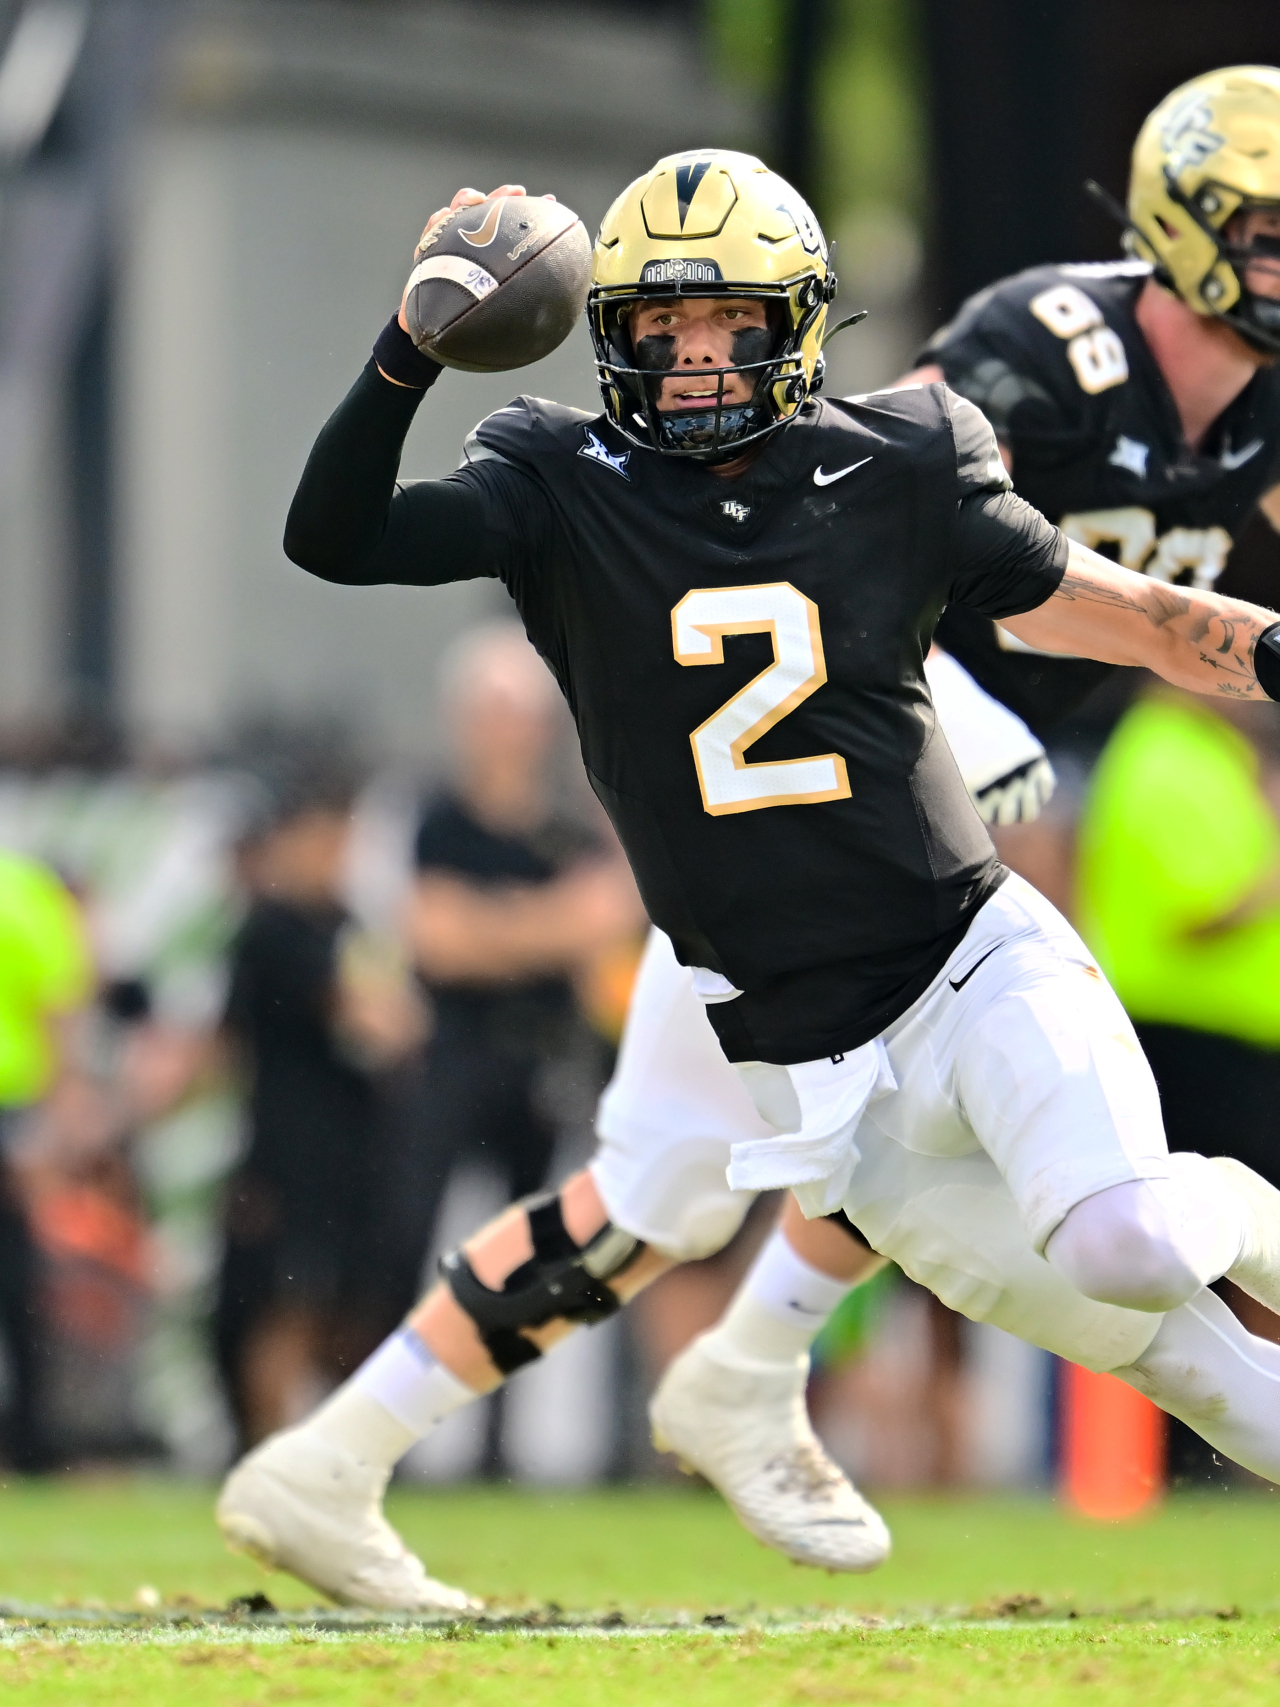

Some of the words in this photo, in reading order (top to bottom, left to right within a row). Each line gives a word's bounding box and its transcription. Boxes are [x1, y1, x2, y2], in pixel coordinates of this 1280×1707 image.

[645, 261, 715, 282] ORLNDO
[720, 500, 750, 522] UCF
[671, 578, 852, 816] 2
